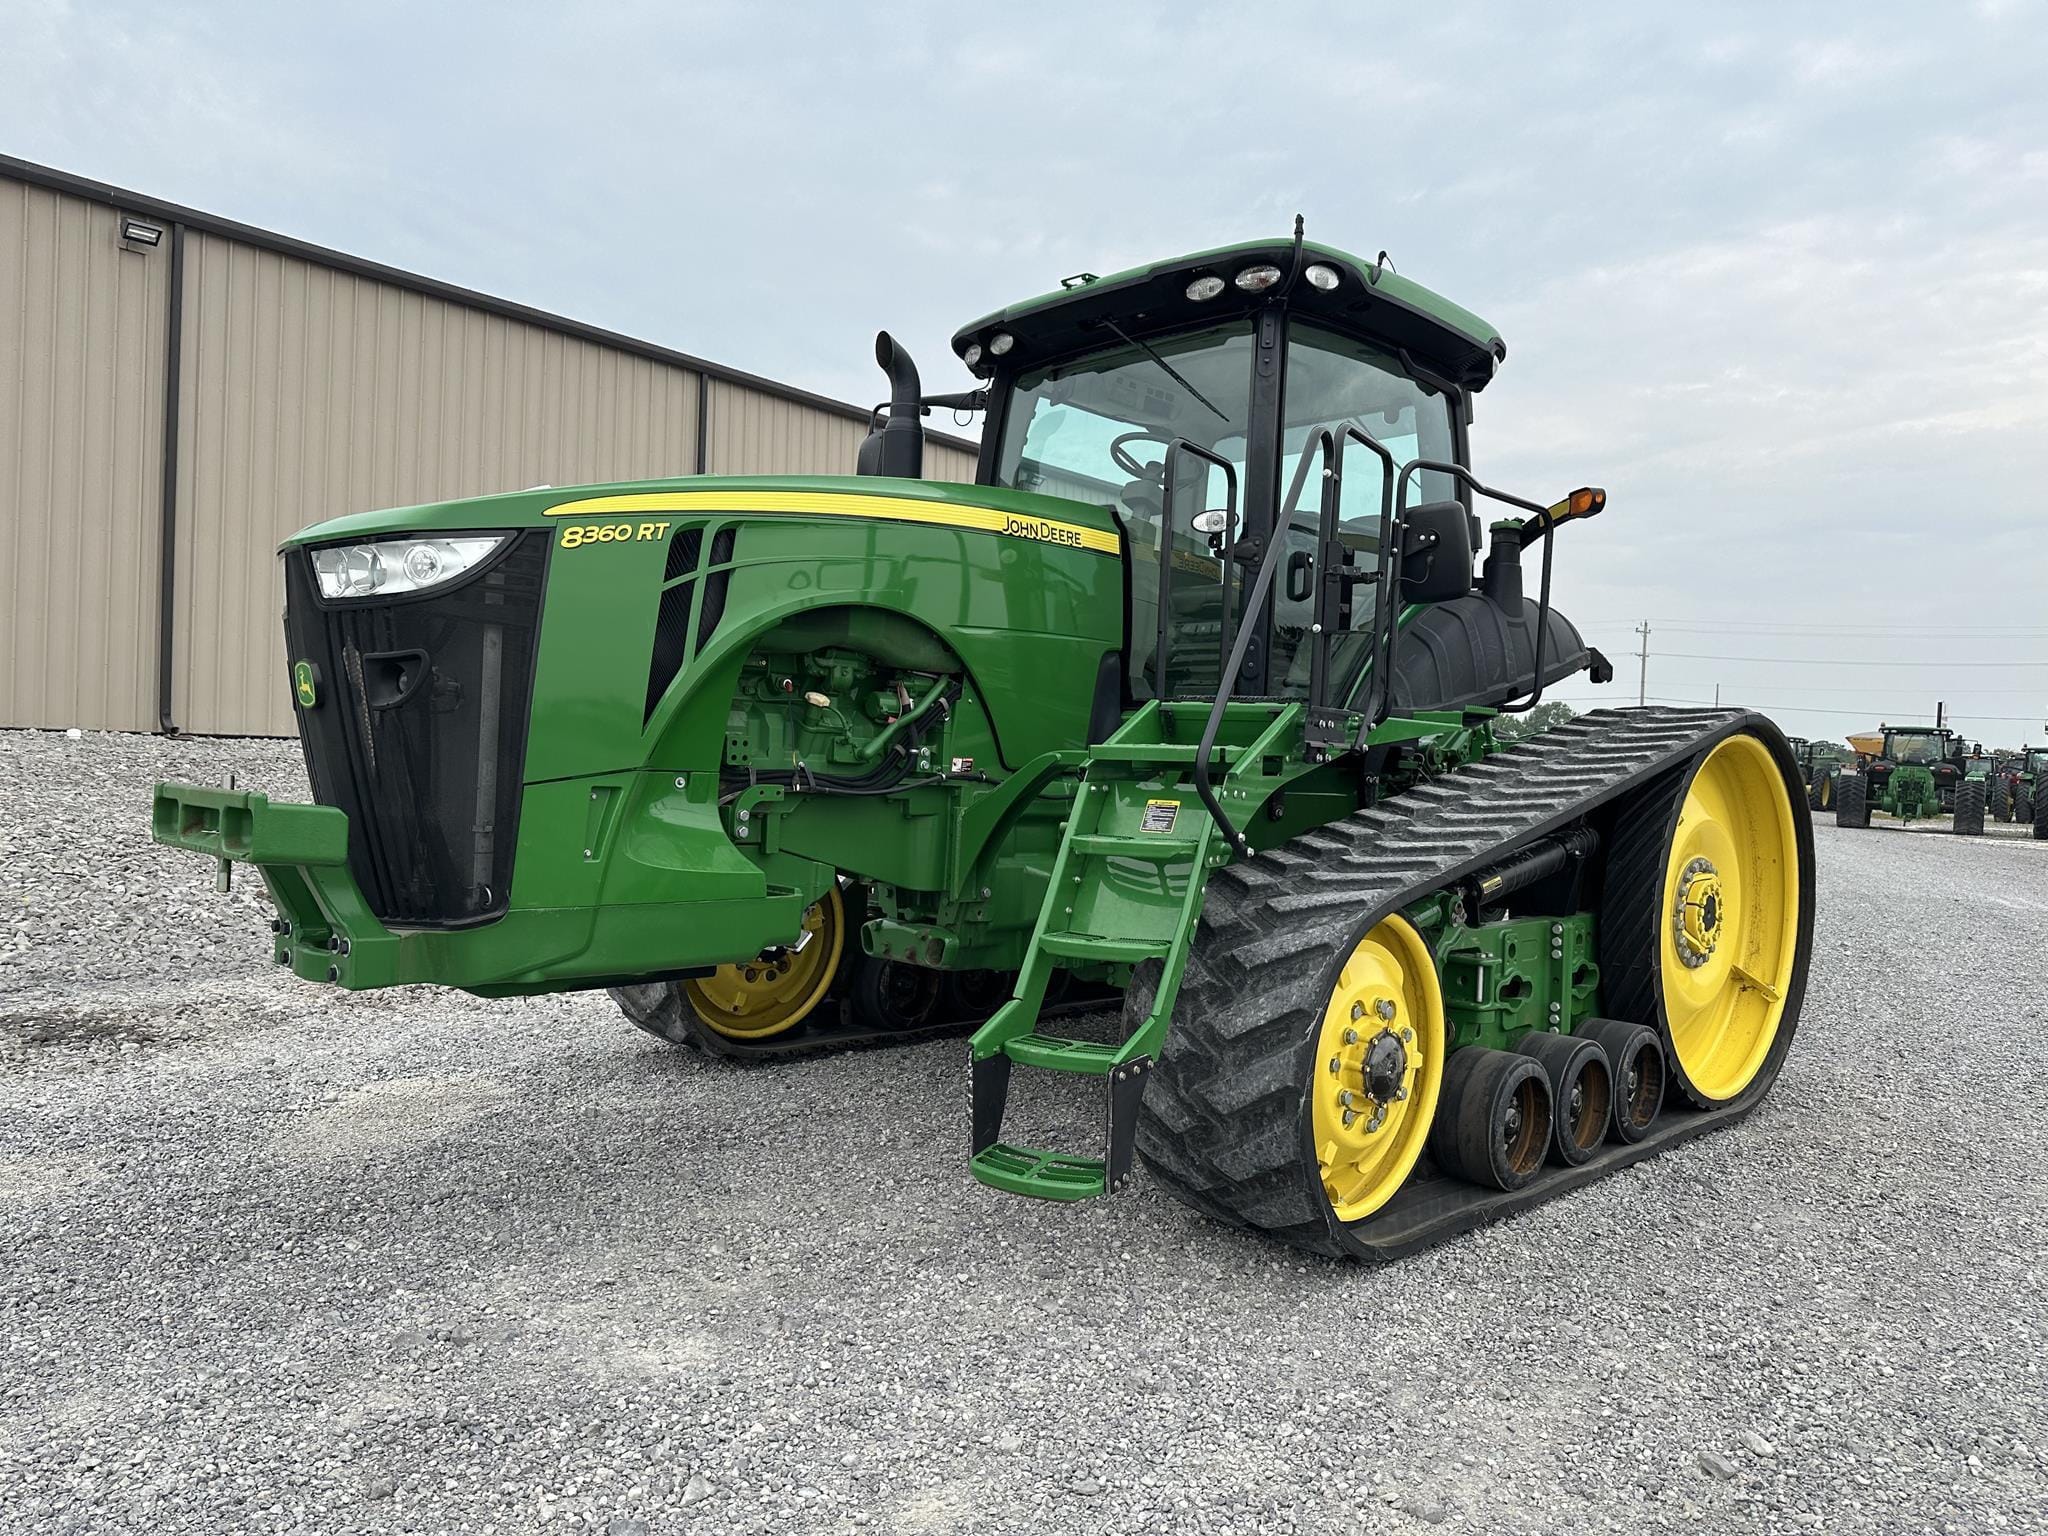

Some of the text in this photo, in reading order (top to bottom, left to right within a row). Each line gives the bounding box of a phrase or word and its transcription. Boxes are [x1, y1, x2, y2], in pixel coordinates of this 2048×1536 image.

[560, 522, 671, 549] 8360 RT
[1002, 516, 1082, 545] JOHN DEERE
